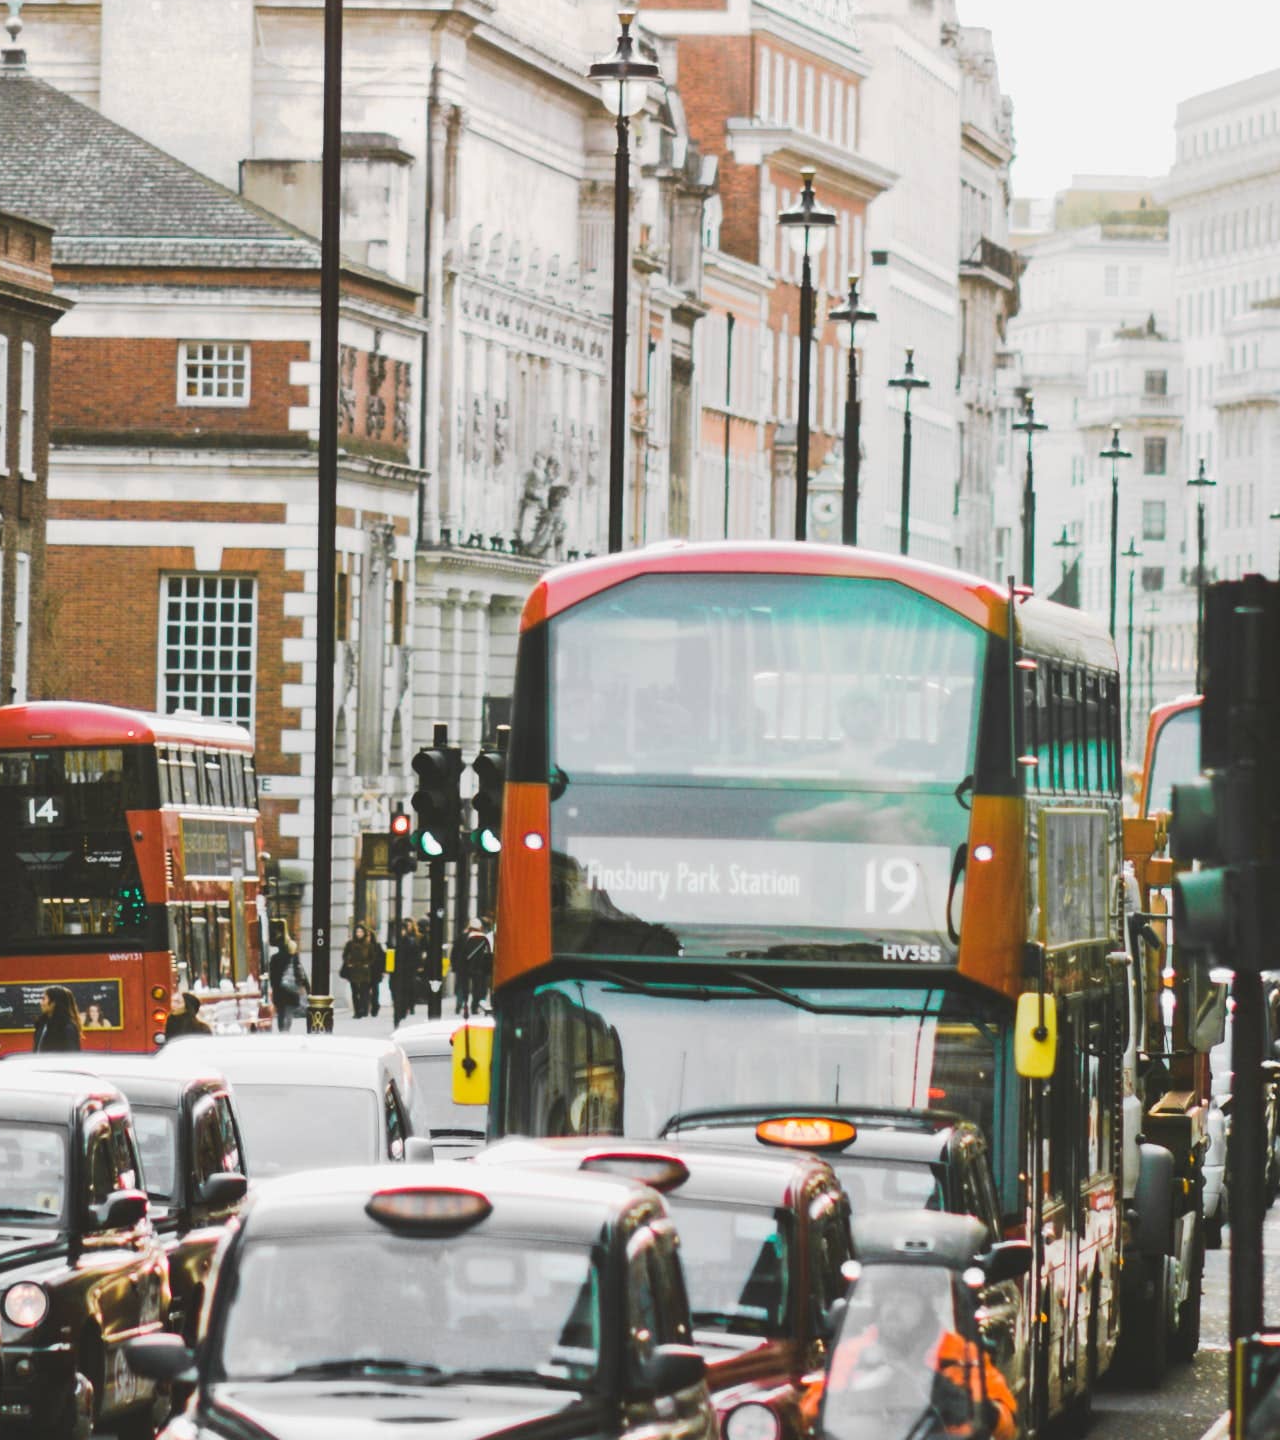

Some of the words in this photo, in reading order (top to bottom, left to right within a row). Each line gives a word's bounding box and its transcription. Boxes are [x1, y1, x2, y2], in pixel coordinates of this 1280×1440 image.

[28, 797, 59, 825] 14
[586, 859, 669, 901] Finsbury
[675, 863, 720, 895] Park
[727, 867, 801, 897] Station
[864, 857, 918, 915] 19
[881, 943, 942, 962] HV355
